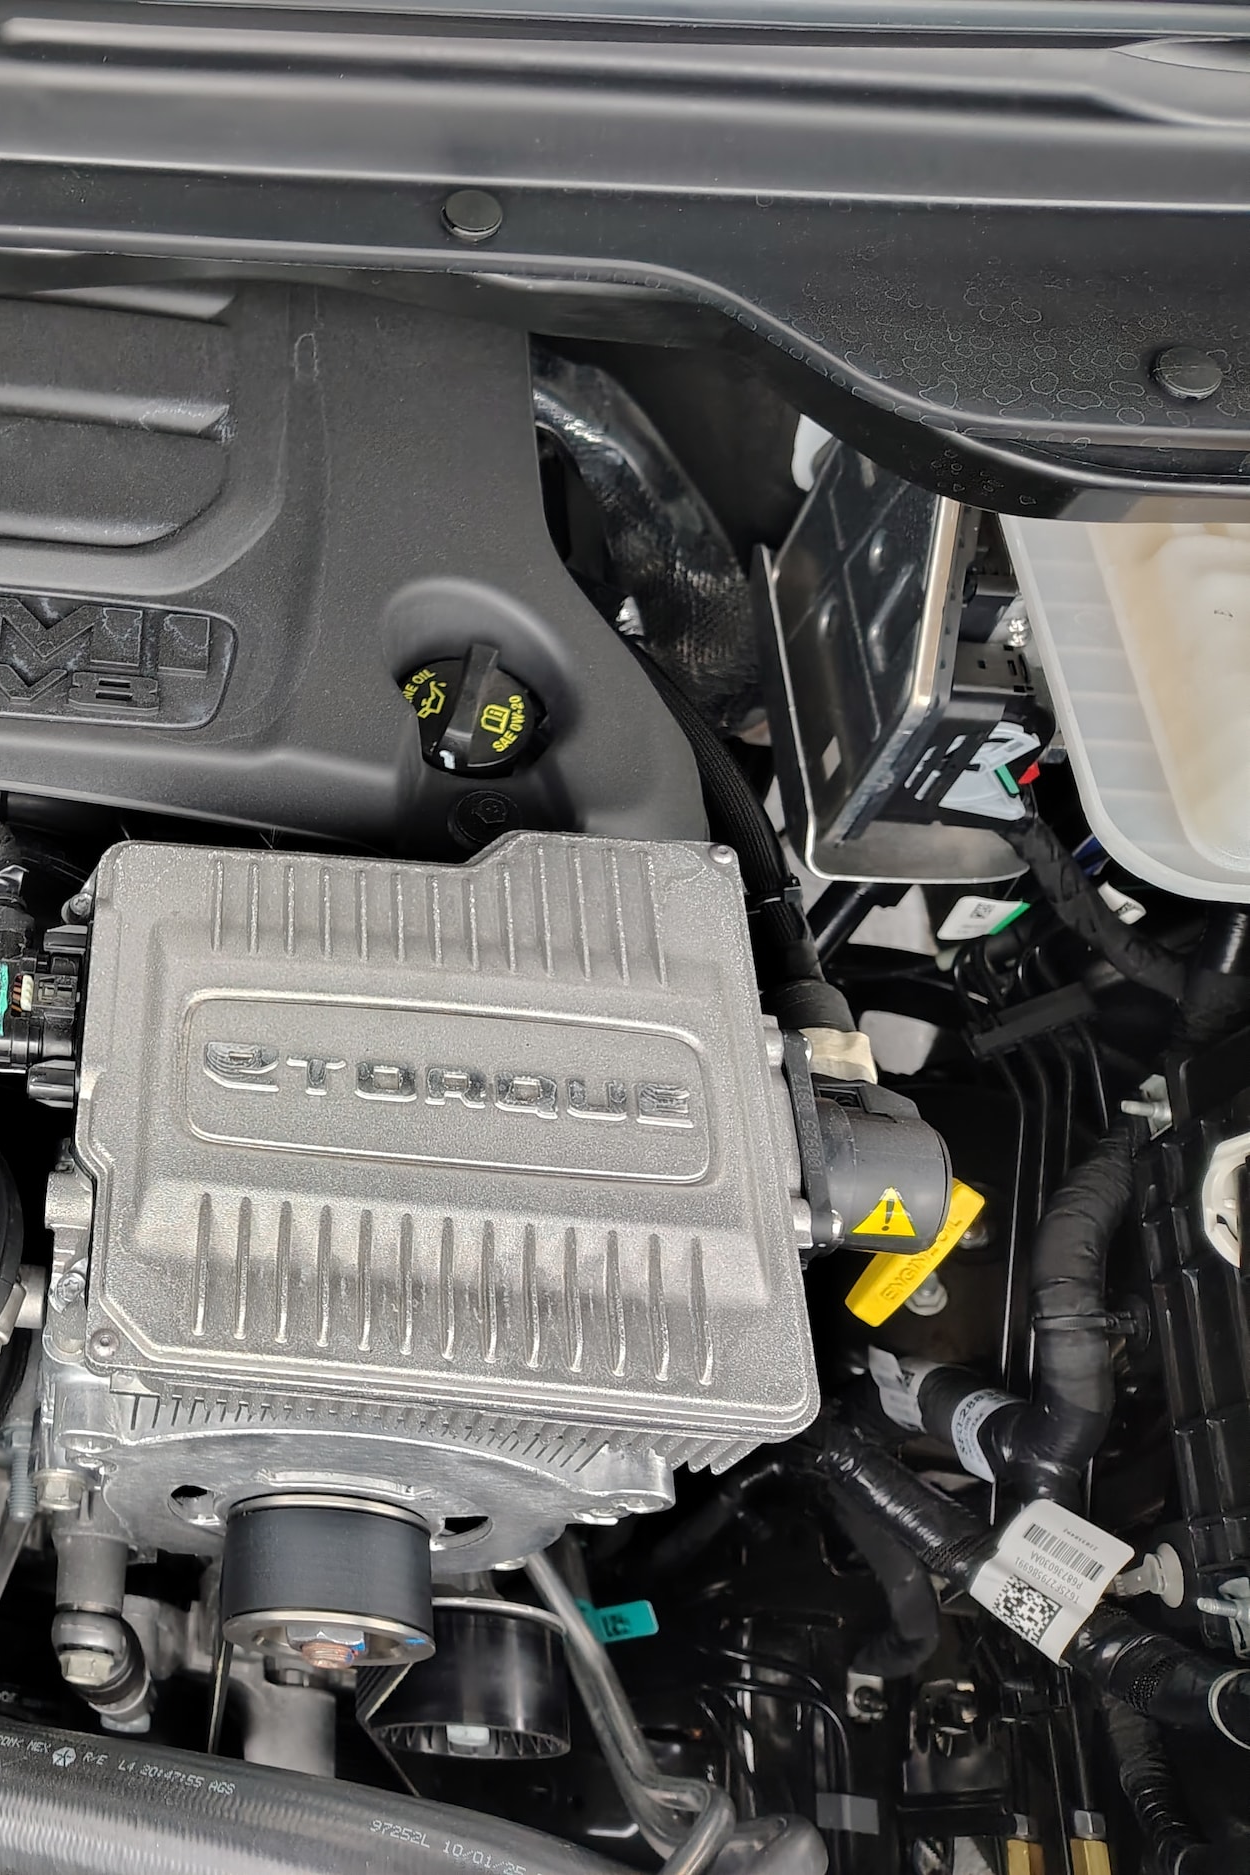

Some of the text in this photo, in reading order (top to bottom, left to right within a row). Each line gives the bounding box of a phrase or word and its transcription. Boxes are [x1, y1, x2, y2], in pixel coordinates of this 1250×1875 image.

[411, 668, 437, 685] OIL
[491, 730, 518, 753] SAE
[203, 1041, 695, 1129] eTORQUE
[207, 1778, 236, 1795] AGS
[369, 1819, 431, 1849] 97252L
